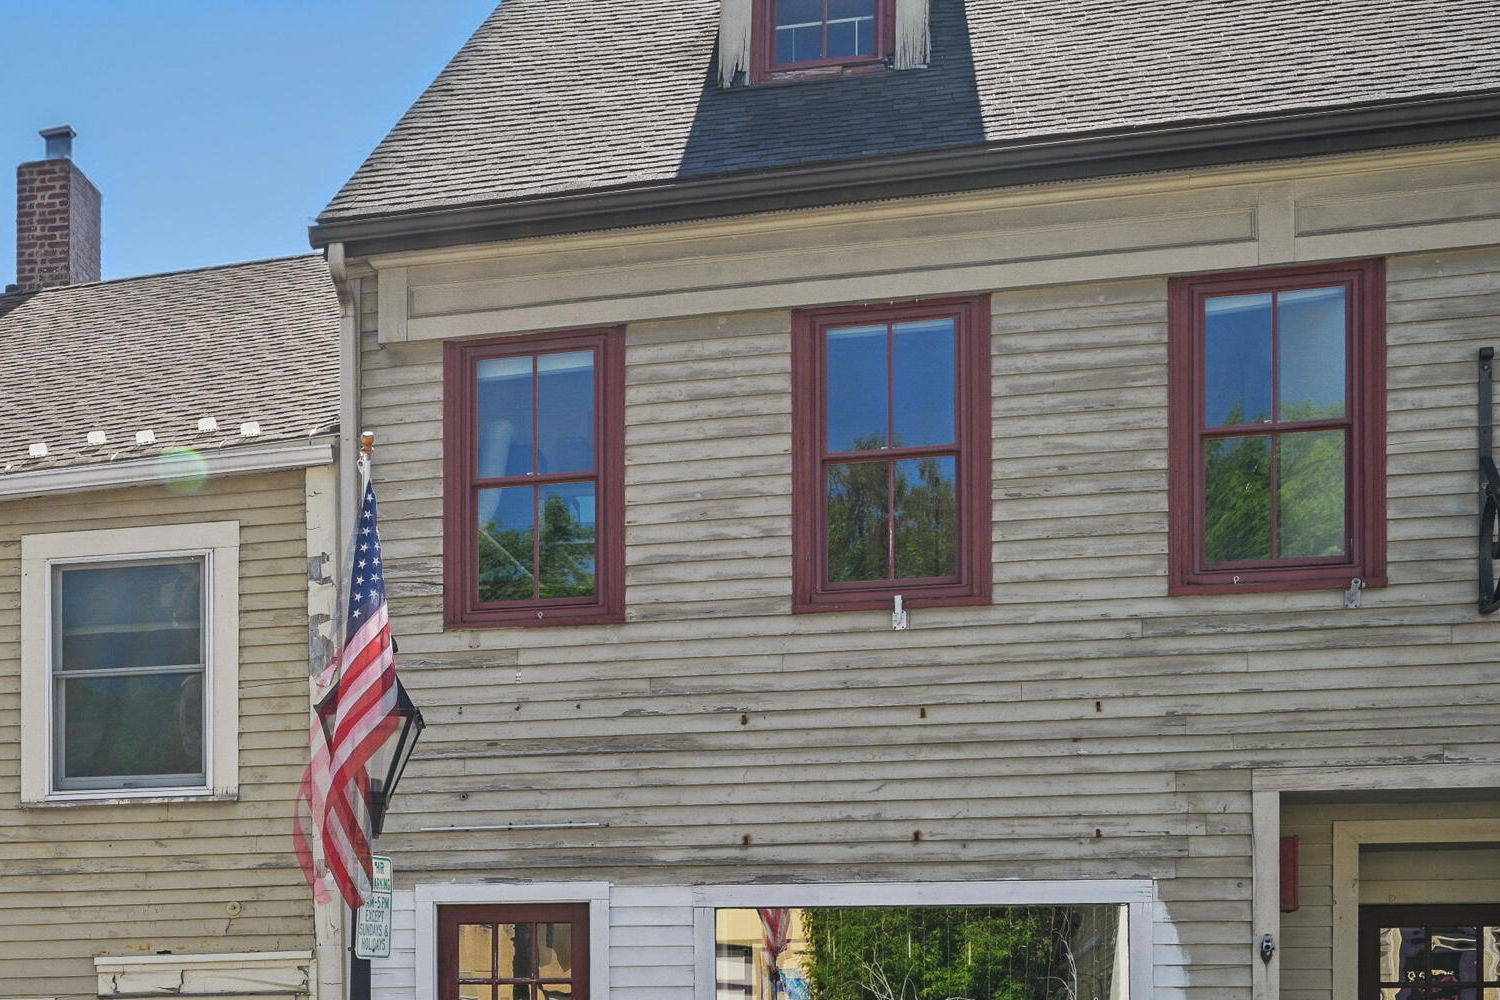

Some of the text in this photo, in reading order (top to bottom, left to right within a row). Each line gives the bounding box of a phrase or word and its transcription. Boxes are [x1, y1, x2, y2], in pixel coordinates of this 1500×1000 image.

[365, 909, 384, 922] EXCEPT
[359, 924, 382, 937] SUNDAYS
[361, 938, 386, 951] HOLIDAYS
